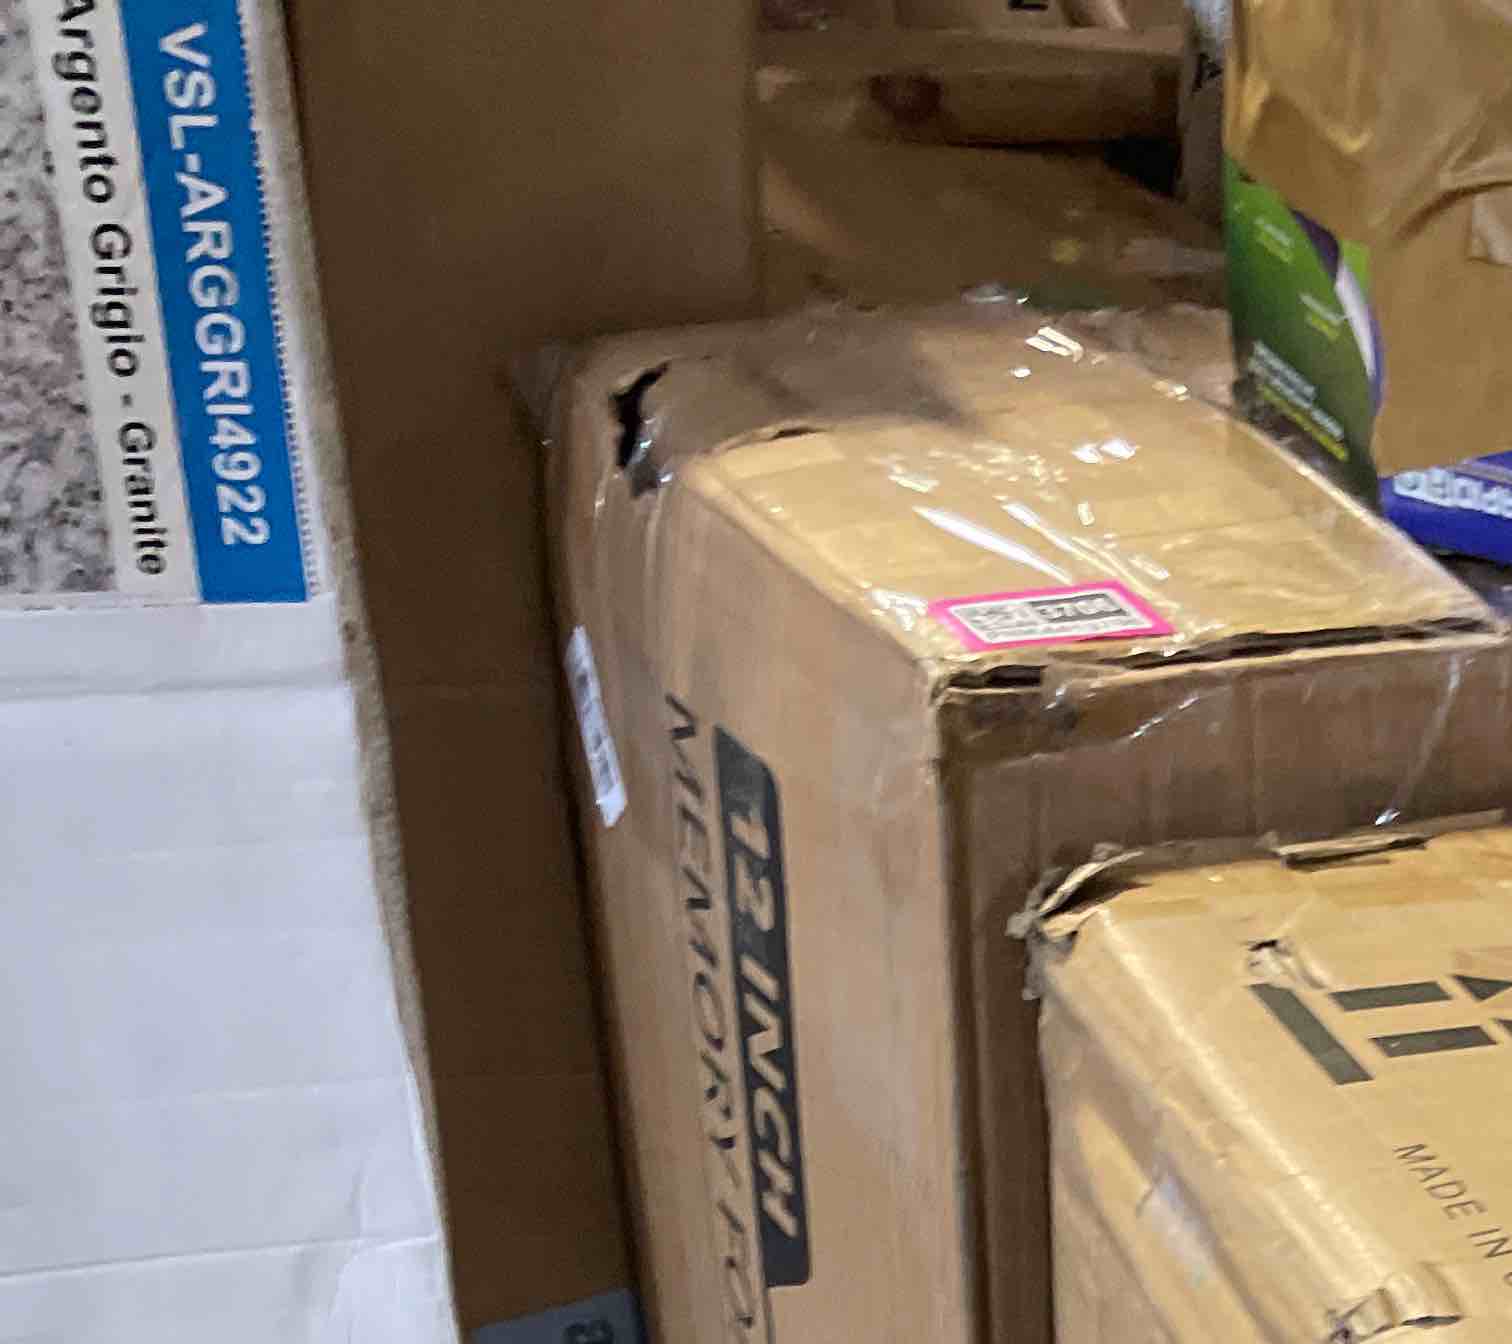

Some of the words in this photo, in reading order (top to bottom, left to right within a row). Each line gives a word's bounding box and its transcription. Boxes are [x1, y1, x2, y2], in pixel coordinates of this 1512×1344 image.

[89, 222, 145, 379] Grigio
[118, 420, 167, 577] Granite
[159, 21, 270, 547] VSL-ARGGRI4922
[666, 691, 742, 1189] MEMORY
[740, 952, 799, 1239] INCH
[1395, 1142, 1487, 1221] MADE
